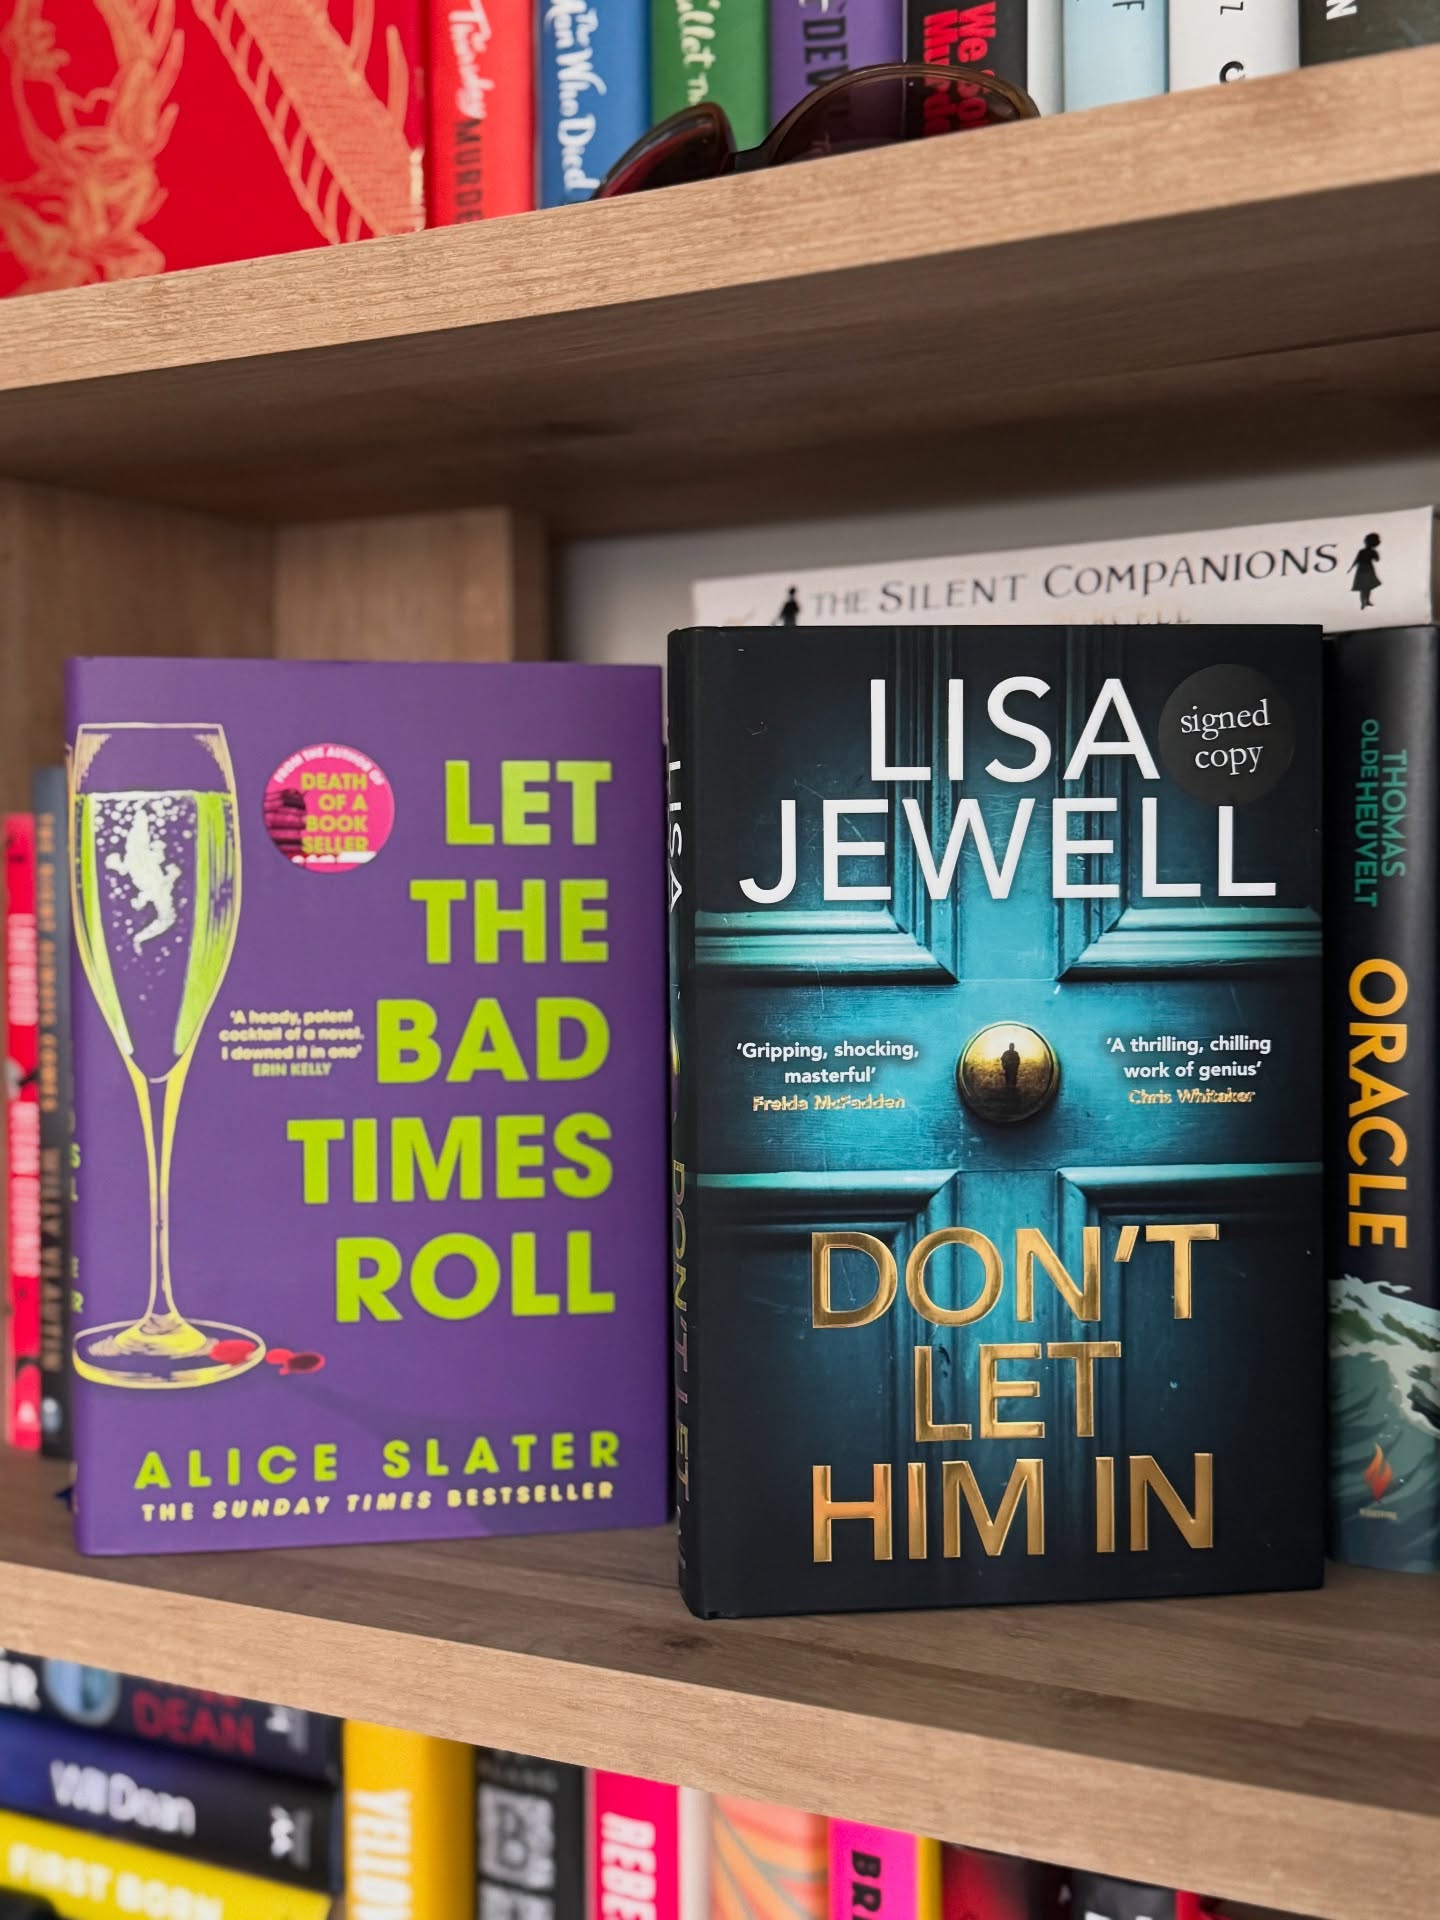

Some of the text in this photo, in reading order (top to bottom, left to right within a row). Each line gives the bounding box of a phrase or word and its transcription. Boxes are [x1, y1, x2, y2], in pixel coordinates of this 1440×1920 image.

[957, 0, 997, 64] We
[555, 48, 608, 117] Who
[556, 114, 601, 191] Died
[813, 541, 1340, 618] THE SILENT COMPANIONS
[870, 675, 1160, 783] LISA
[1180, 698, 1272, 741] signed
[301, 772, 368, 791] DEATH
[1194, 745, 1264, 776] copy
[304, 814, 369, 833] BOOK
[318, 793, 369, 812] OF A
[444, 759, 612, 845] LET
[1380, 749, 1408, 878] THOMAS
[301, 835, 369, 853] SELLER
[738, 796, 1277, 905] JEWELL
[409, 878, 610, 965] THE
[289, 1062, 332, 1077] KELLY
[376, 996, 611, 1085] BAD
[736, 1039, 920, 1063] 'Gripping, shocking,
[1123, 1060, 1263, 1081] work of genius'
[1130, 1035, 1205, 1056] thrilling,
[1209, 1034, 1272, 1054] chilling
[783, 1065, 877, 1084] masterful'
[813, 1093, 906, 1111] McFadden
[1128, 1086, 1256, 1104] Chris Whitaker
[1348, 957, 1410, 1250] ORACLE
[286, 1111, 613, 1205] TIMES
[336, 1230, 616, 1323] ROLL
[811, 1223, 1220, 1328] DON'T
[913, 1340, 1122, 1443] LET
[133, 1429, 621, 1491] ALICE SLATER
[141, 1480, 614, 1523] THE SUNDAY TIMES BESTSELLER
[812, 1452, 1214, 1563] HIM IN
[131, 1690, 256, 1757] DEAN
